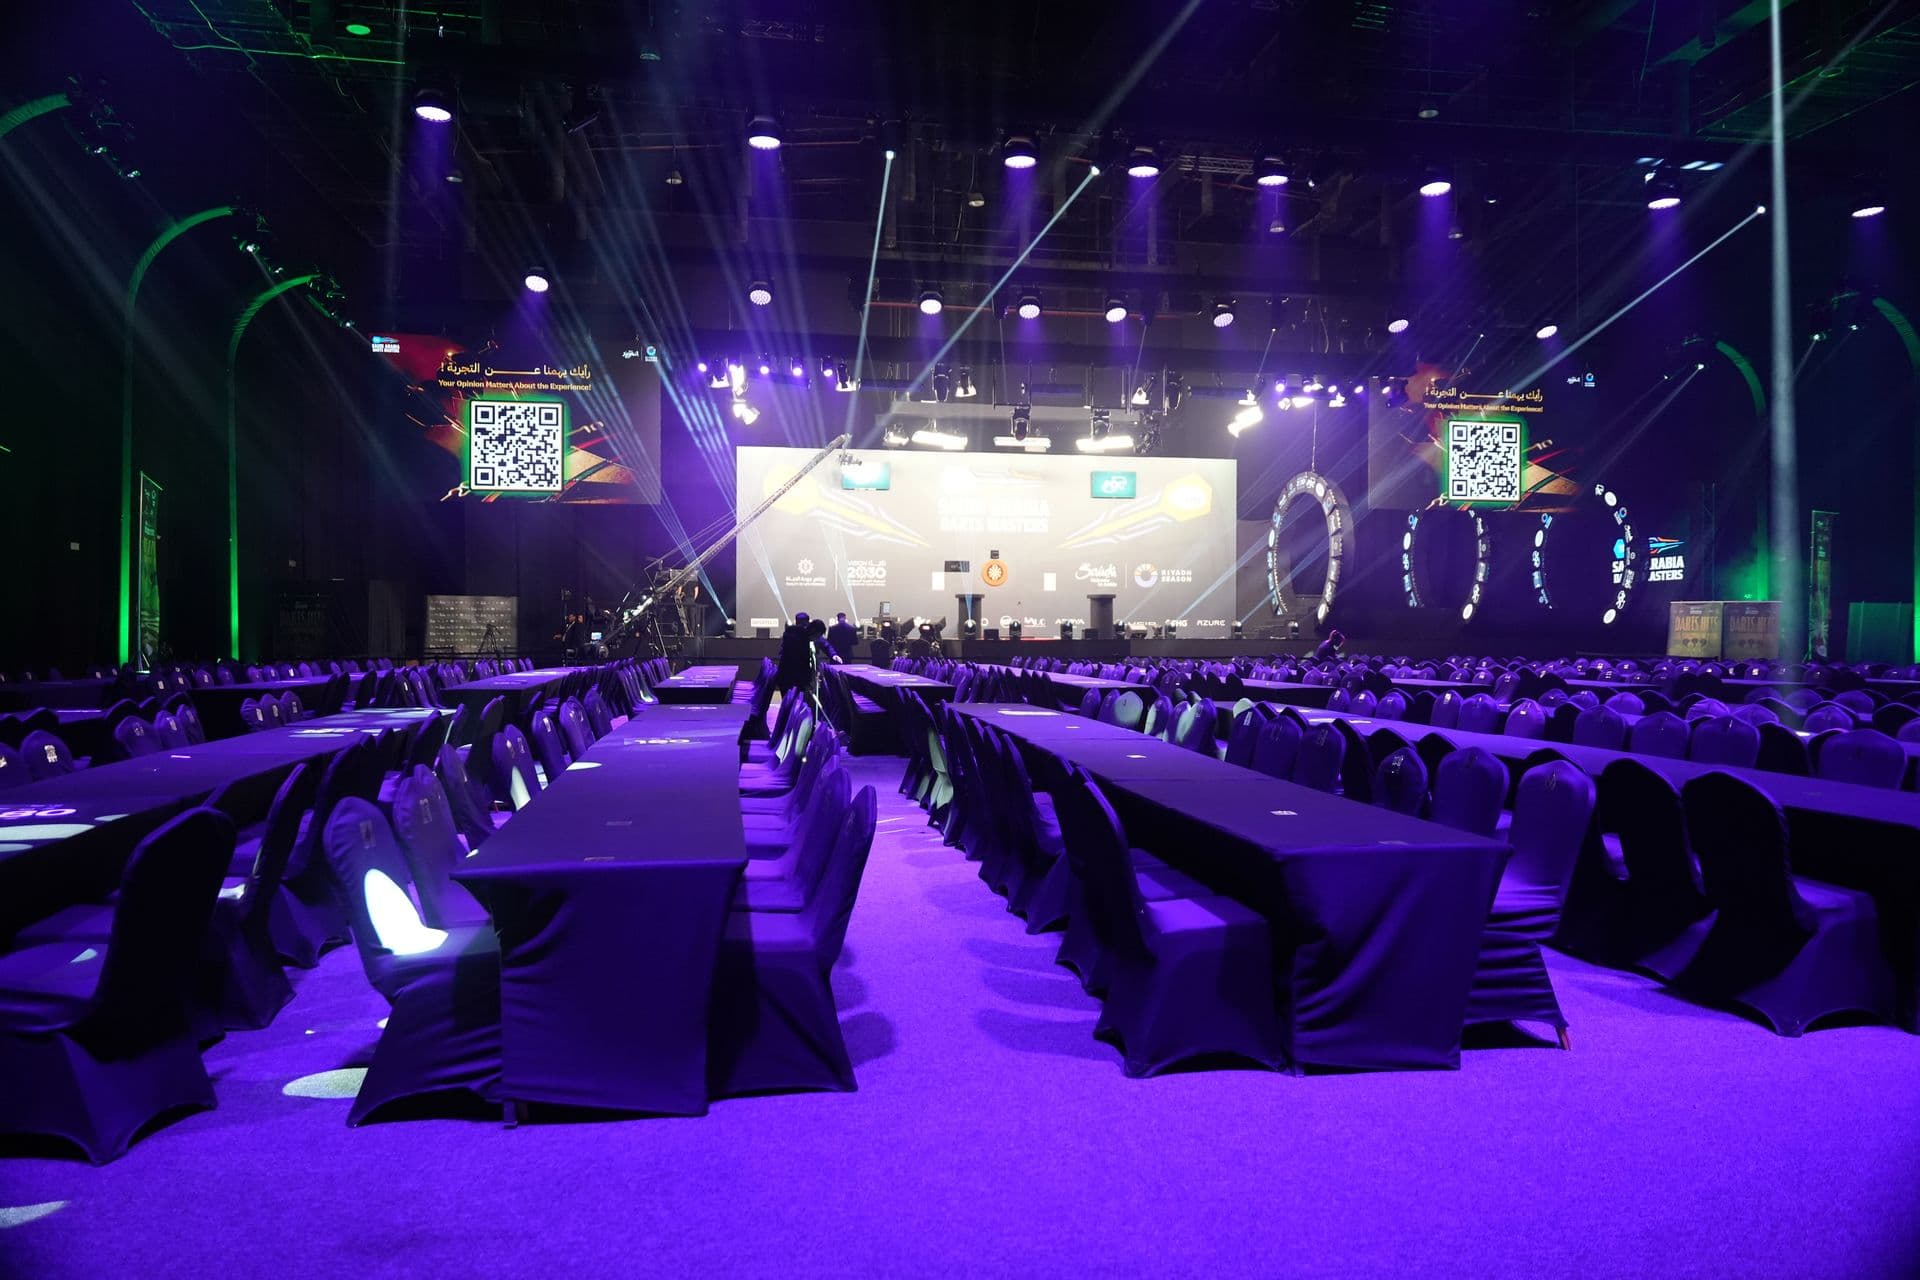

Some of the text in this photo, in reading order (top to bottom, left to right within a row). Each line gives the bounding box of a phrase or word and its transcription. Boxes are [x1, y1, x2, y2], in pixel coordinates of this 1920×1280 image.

[447, 361, 480, 376] التجربة
[544, 364, 567, 378] يهمنا
[570, 363, 591, 380] رأيك
[438, 379, 455, 388] Your
[456, 380, 484, 389] Opinion
[485, 381, 513, 389] Matters
[514, 382, 535, 390] About
[550, 383, 592, 391] Experience!
[1430, 386, 1456, 399] التجربة
[1506, 389, 1524, 402] يهمنا
[1526, 388, 1543, 402] رأيك
[1649, 555, 1685, 570] RABIA
[847, 566, 887, 579] 2030
[1647, 569, 1684, 582] ASTERS
